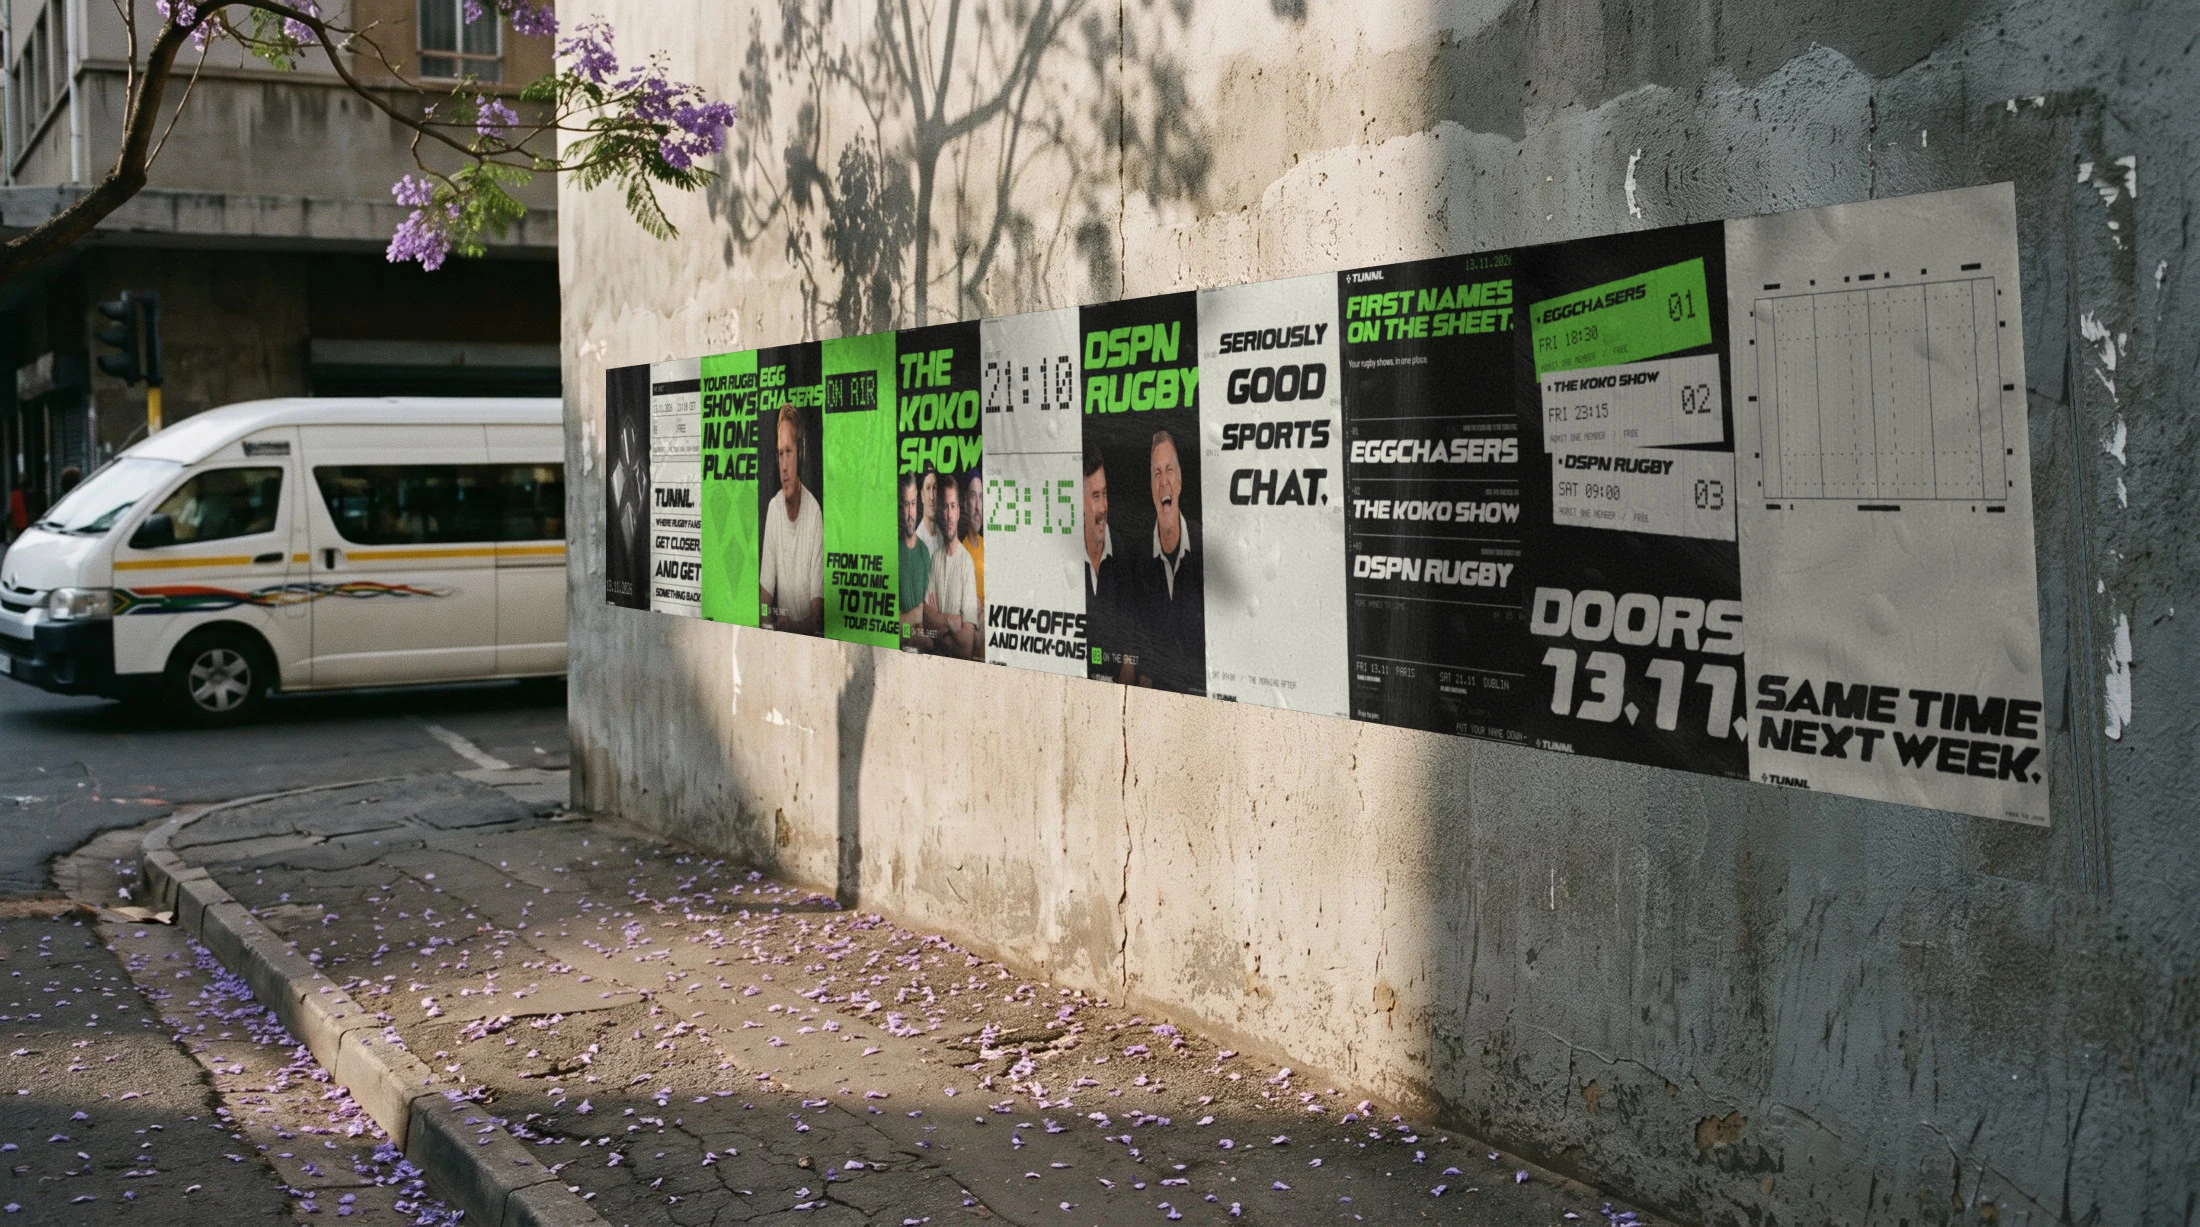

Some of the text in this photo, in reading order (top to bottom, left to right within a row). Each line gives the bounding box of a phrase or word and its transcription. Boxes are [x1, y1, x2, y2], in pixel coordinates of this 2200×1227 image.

[1352, 271, 1384, 283] TUNNL
[1346, 279, 1513, 319] FIRST NAMES
[1542, 284, 1646, 324] EGGCHASERS
[1668, 289, 1696, 322] 01
[1219, 322, 1328, 354] SERIOUSLY
[1347, 319, 1381, 344] ON
[1384, 315, 1430, 340] THE
[1538, 325, 1599, 353] FRI 18:30
[1084, 320, 1181, 370] DSPN
[760, 365, 786, 387] EGG
[900, 348, 954, 389] THE
[1361, 358, 1376, 369] rugby
[703, 373, 758, 392] YOUR RUGBY
[827, 376, 876, 408] ON AIR
[985, 355, 1072, 414] 21:10
[1085, 366, 1199, 414] RUGBY
[1227, 363, 1326, 404] GOOD
[1553, 371, 1660, 392] THE KOKO SHOW
[703, 391, 757, 418] SHOWS
[760, 384, 823, 411] CHASERS
[900, 390, 980, 432] KOKO
[1681, 384, 1711, 414] 02
[1548, 403, 1609, 422] FRI 23:15
[703, 420, 758, 449] IN ONE
[1221, 419, 1331, 451] SPORTS
[900, 434, 983, 475] SHOW
[1350, 438, 1518, 463] EGGCHASERS
[1565, 454, 1673, 475] DSPN RUGBY
[703, 453, 758, 481] PLACE
[1229, 468, 1328, 506] CHAT.
[1559, 482, 1620, 500] SAT 09:00
[1695, 480, 1723, 510] 03
[987, 480, 1075, 534] 23:15
[1353, 499, 1391, 519] THE
[1392, 500, 1453, 521] KOKO
[1455, 502, 1520, 523] SHOW
[672, 519, 687, 528] RUGBY
[655, 536, 670, 549] GET
[655, 560, 701, 581] AND GET
[827, 552, 883, 571] FROM THE
[1353, 555, 1514, 588] DSPN RUGBY
[832, 571, 889, 590] STUDIO MIC
[839, 589, 896, 617] TO THE
[844, 615, 899, 635] TOUR STAGE
[988, 604, 1087, 639] KICK-OFFS
[1530, 586, 1744, 656] DOORS
[989, 632, 1018, 650] AND
[1356, 661, 1415, 678] FRI 13.11 PARIS
[1483, 677, 1509, 690] DUBLIN
[1542, 647, 1748, 741] 13.11.
[1755, 674, 2042, 740] SAME TIME
[1542, 740, 1574, 754] TUNNL
[1758, 715, 2042, 785] NEXT WEEK.
[1769, 774, 1811, 789] TUNNL
